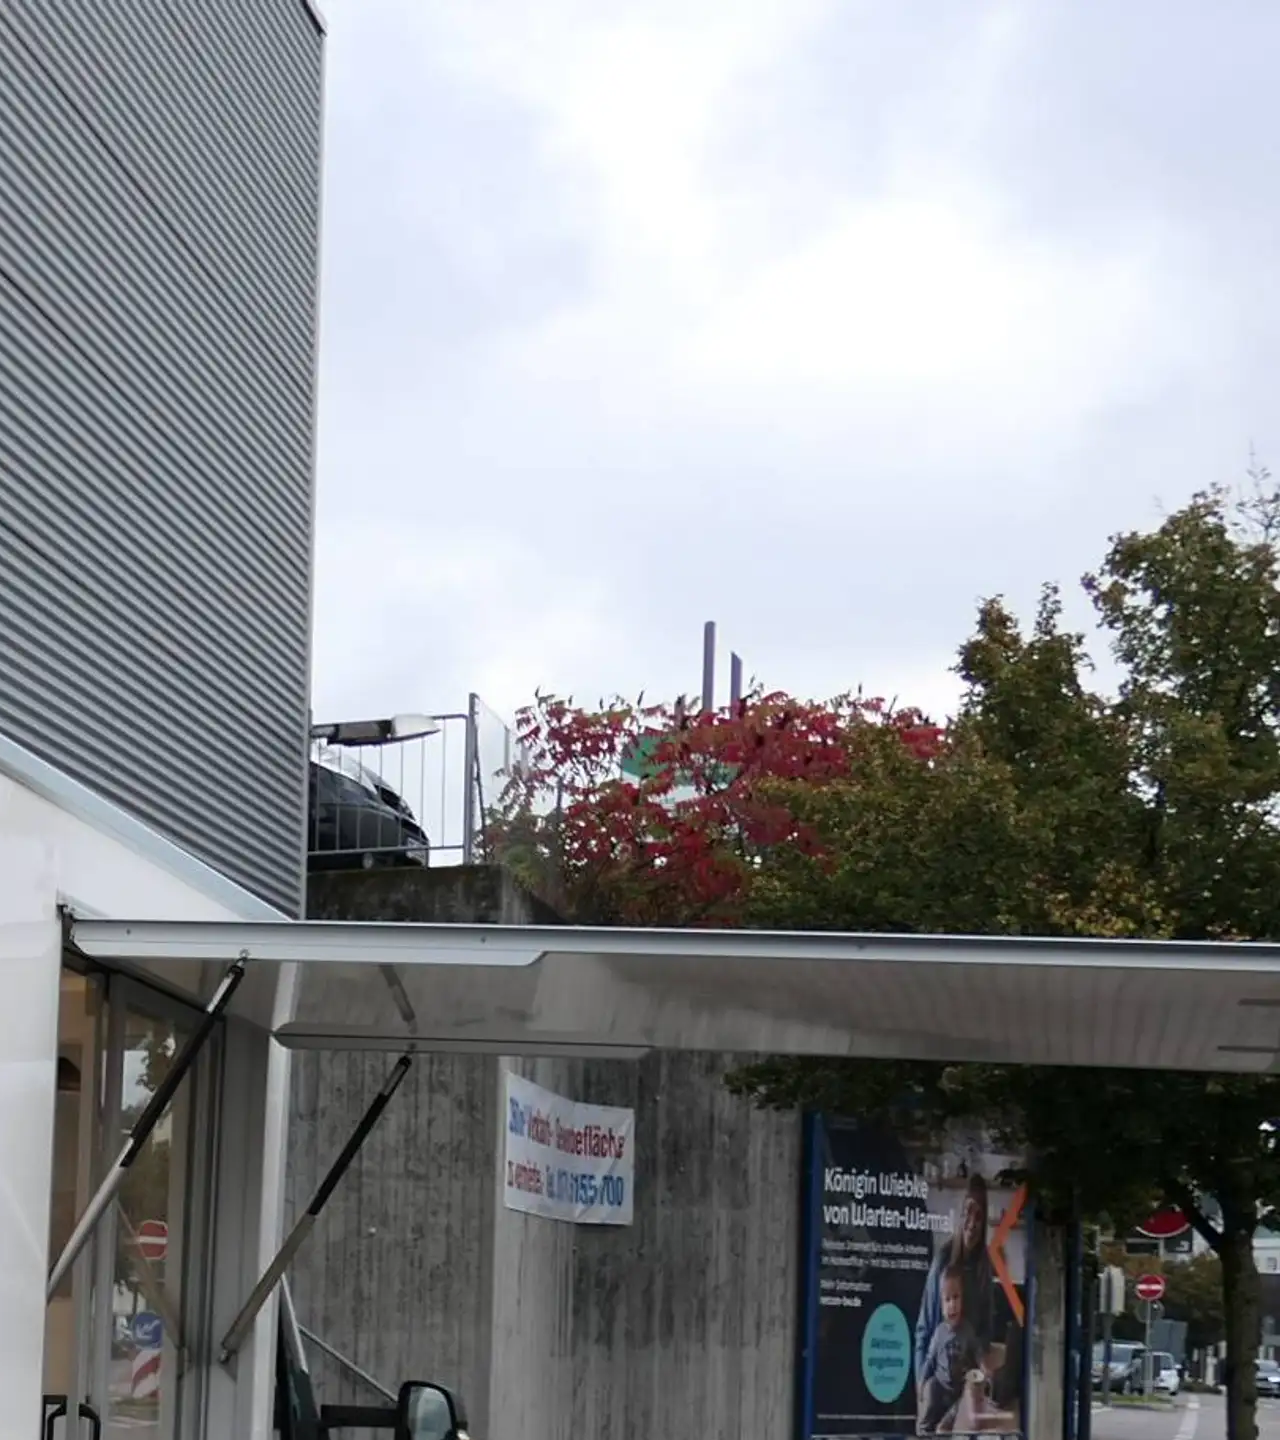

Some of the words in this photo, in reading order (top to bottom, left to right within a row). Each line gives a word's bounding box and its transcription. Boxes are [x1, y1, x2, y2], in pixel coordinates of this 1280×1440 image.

[824, 1167, 877, 1199] Königin
[879, 1172, 929, 1201] Wiebke
[823, 1205, 849, 1225] von
